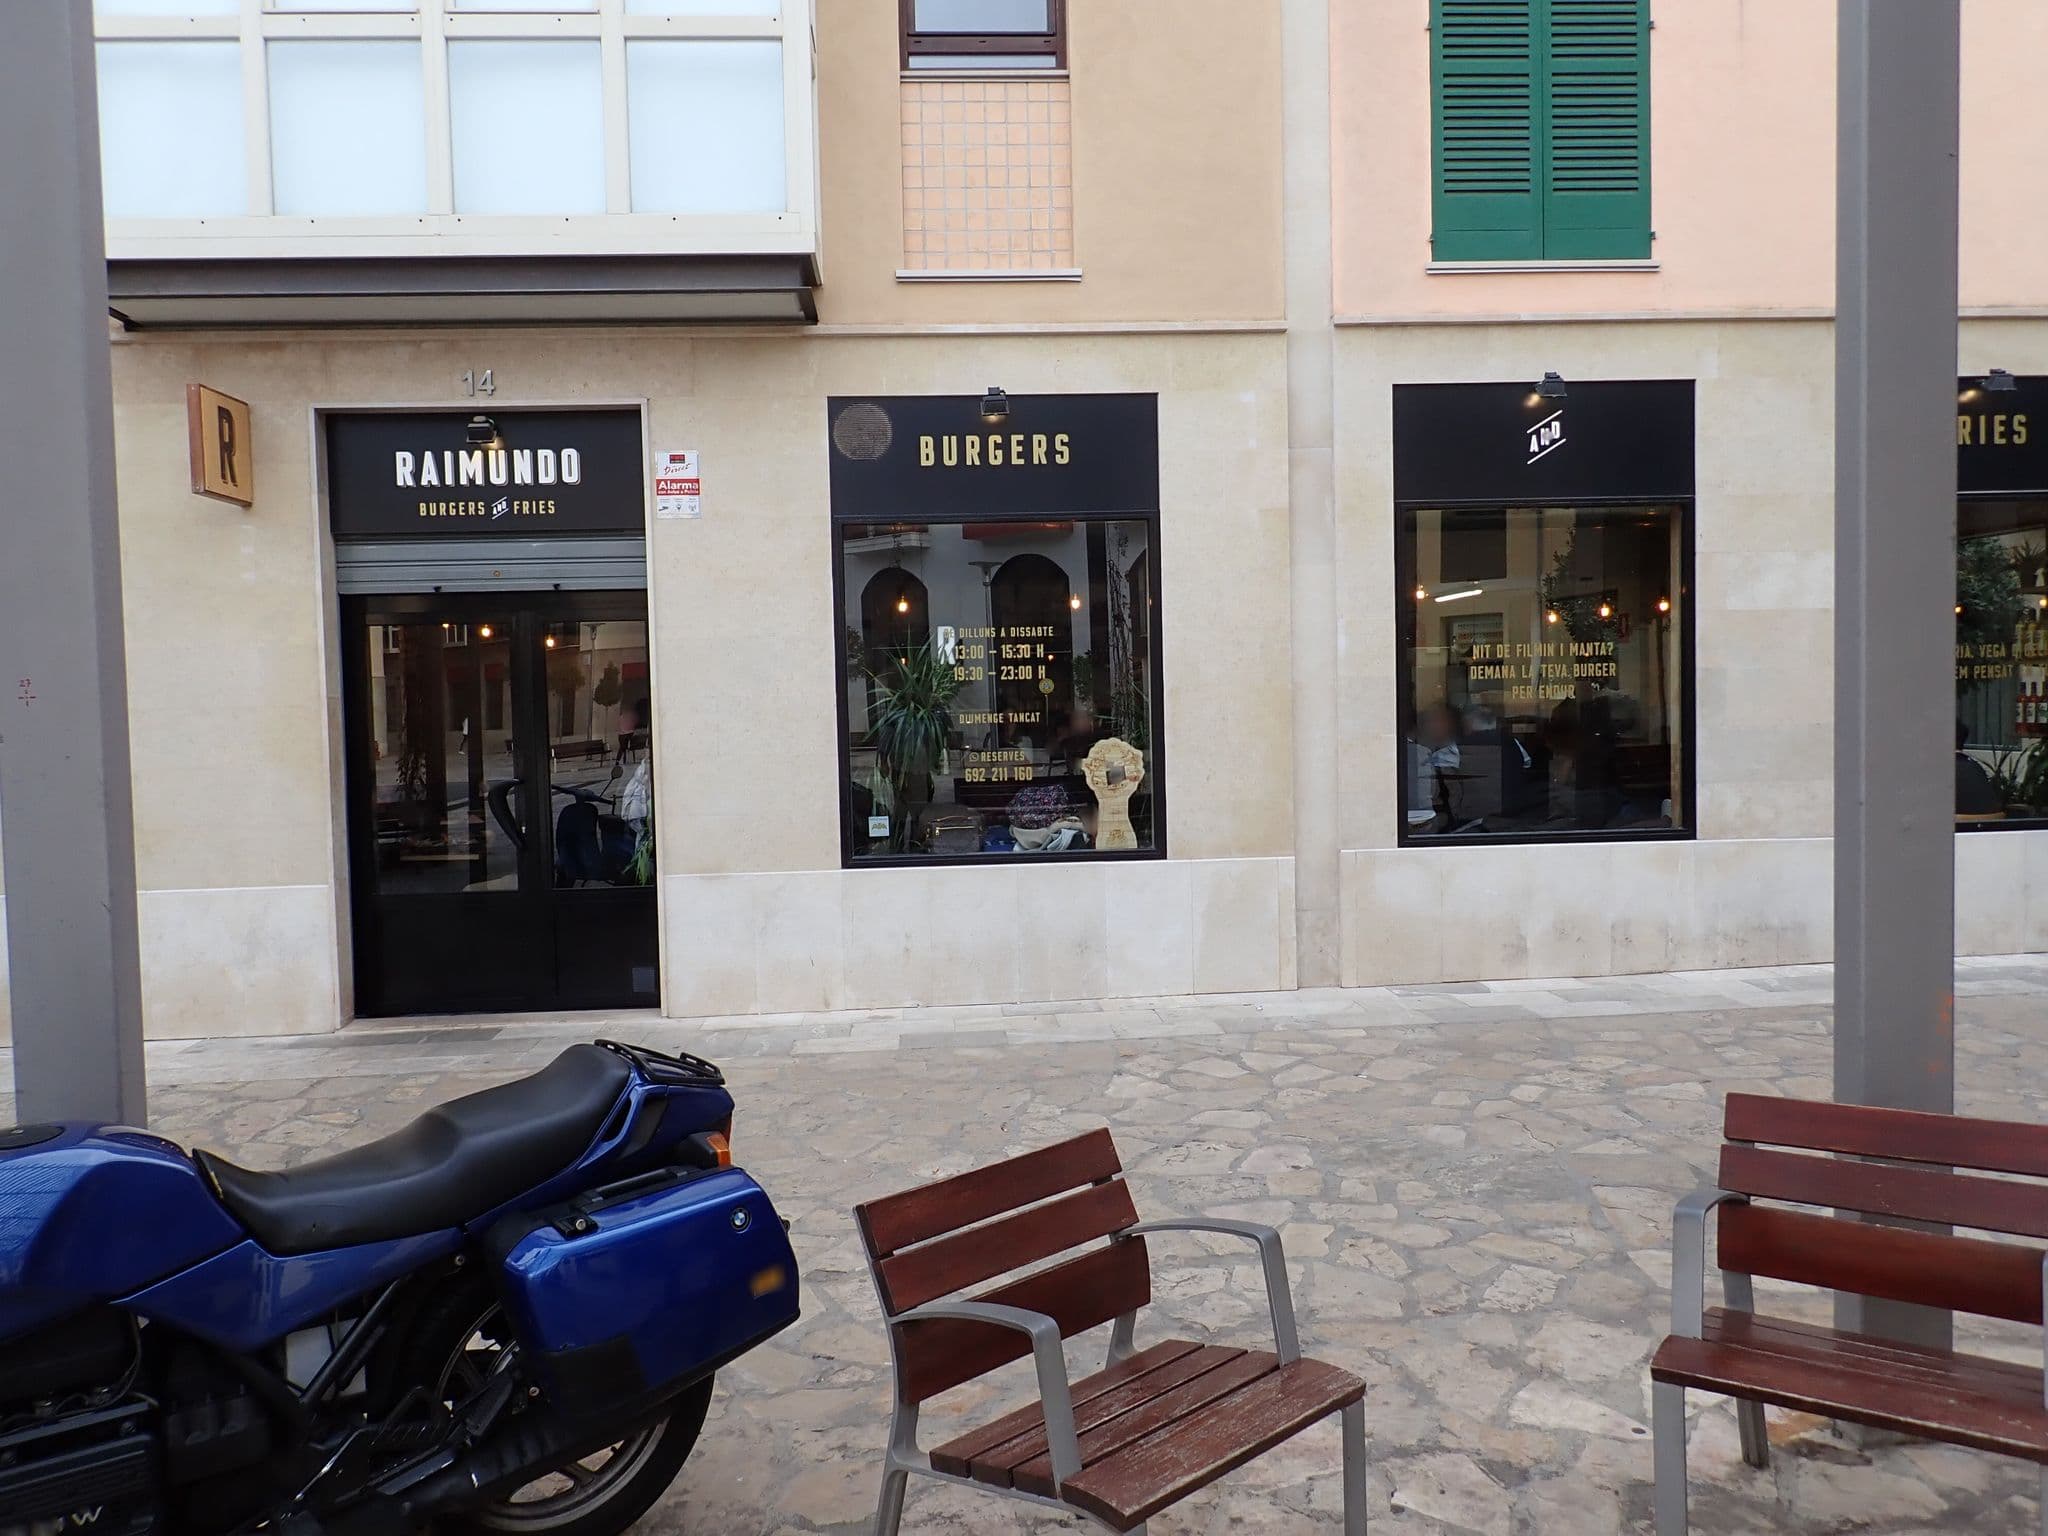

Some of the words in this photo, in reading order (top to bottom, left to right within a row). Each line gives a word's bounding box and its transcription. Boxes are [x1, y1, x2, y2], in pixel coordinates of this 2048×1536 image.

[463, 370, 495, 396] 14
[1529, 420, 1561, 453] AND
[217, 405, 238, 487] R
[919, 433, 1070, 466] BURGERS
[395, 448, 581, 487] RAIMUNDO
[658, 480, 698, 490] Alarma
[419, 502, 485, 516] BURGERS
[513, 500, 556, 515] FRIES
[959, 627, 996, 638] DILLUNS
[1000, 628, 1006, 637] A
[1010, 626, 1054, 637] DISSABTE
[955, 645, 984, 659] 13:00
[1001, 644, 1031, 659] 15:30
[1036, 643, 1044, 658] H
[1472, 644, 1491, 659] NIT
[1496, 643, 1511, 658] DE
[1560, 642, 1564, 656] I
[1569, 641, 1614, 657] MANTA?
[954, 666, 983, 680] 19:30
[1001, 665, 1032, 680] 23:00
[1038, 665, 1046, 679] H
[1470, 664, 1516, 680] DEMANA
[1522, 663, 1534, 678] LA
[1541, 663, 1568, 678] TEVA
[1574, 662, 1616, 677] BURGER
[1512, 686, 1533, 700] PER
[1009, 711, 1041, 723] TANCAT
[981, 750, 1025, 762] RESERVES
[965, 767, 986, 782] 692
[991, 767, 1008, 781] 211
[1014, 766, 1033, 781] 160
